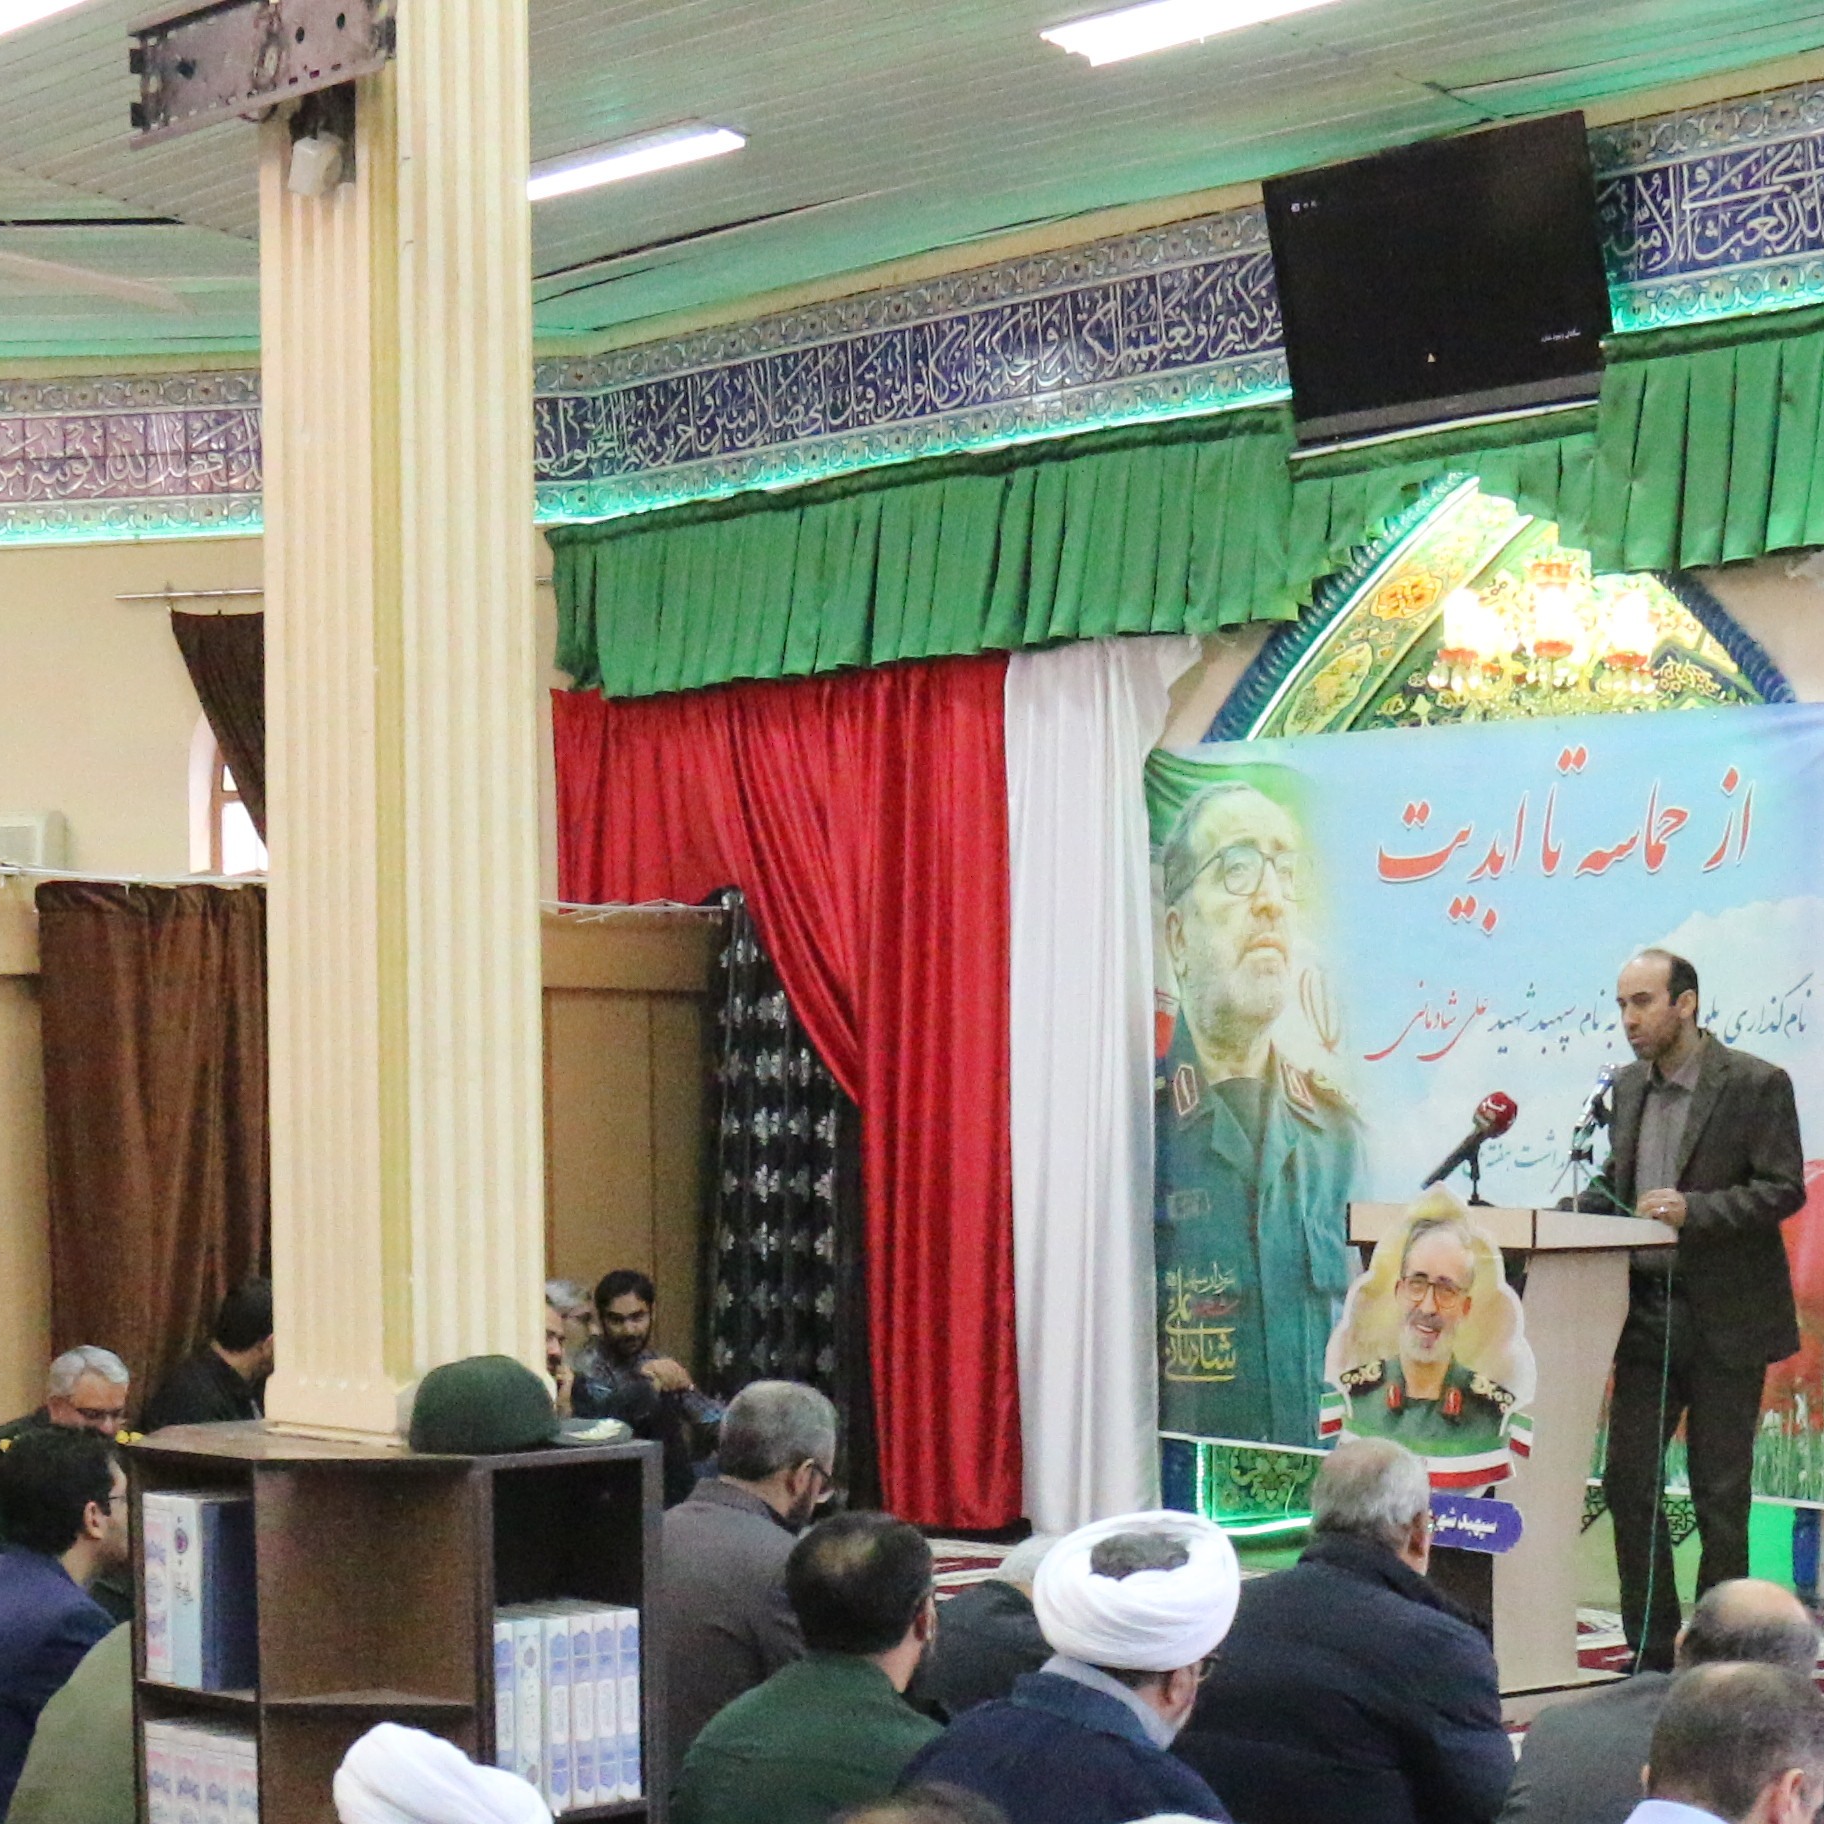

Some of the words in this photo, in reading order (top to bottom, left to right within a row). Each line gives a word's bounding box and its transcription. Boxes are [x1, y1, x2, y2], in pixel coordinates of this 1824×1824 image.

[1541, 744, 1589, 877] تا
[1574, 779, 1689, 879] حماسه
[1701, 765, 1756, 873] از
[1376, 790, 1529, 935] ابدیت
[1363, 979, 1458, 1063] شادمانی
[1416, 996, 1488, 1063] علی
[1487, 982, 1537, 1055] شهید
[1528, 1003, 1577, 1056] سپهبد
[1580, 988, 1606, 1037] نام
[1784, 988, 1813, 1040] نام
